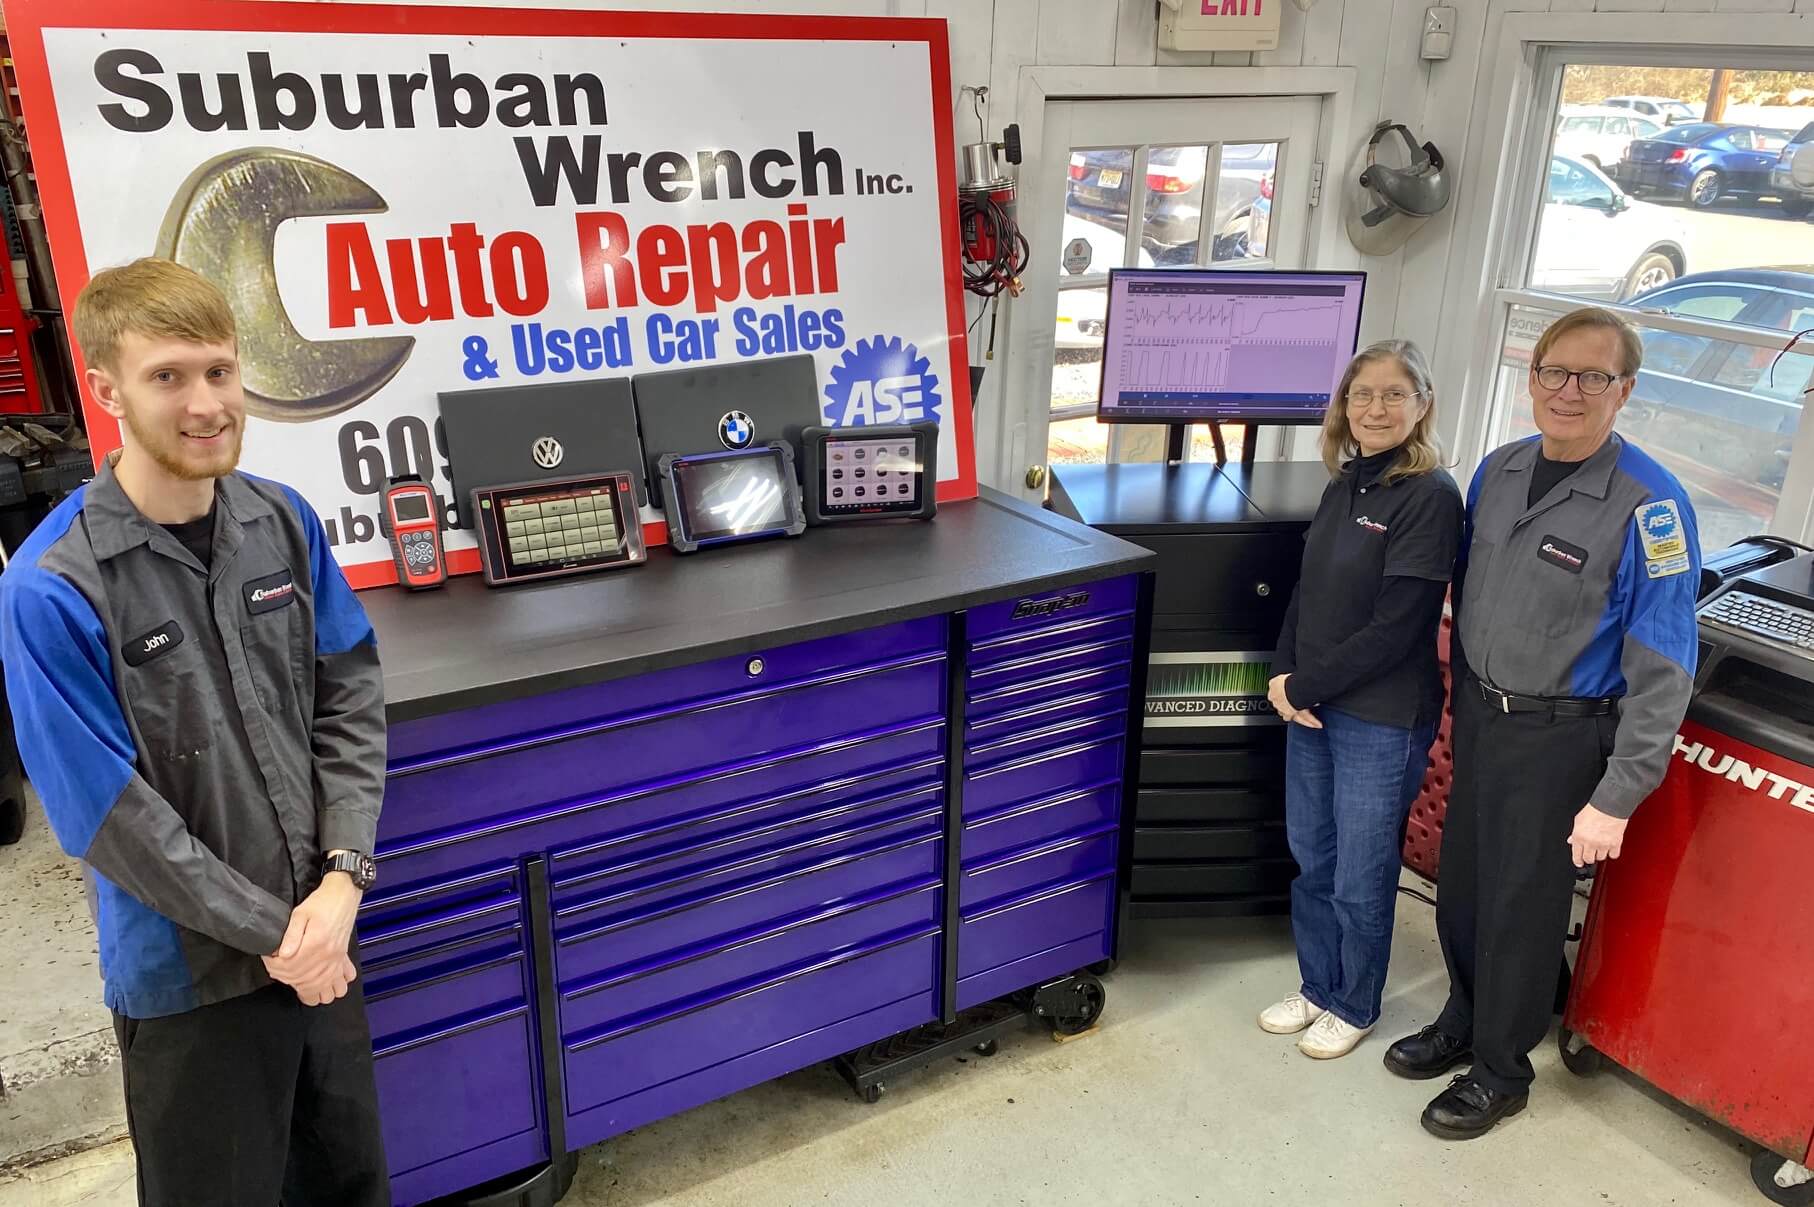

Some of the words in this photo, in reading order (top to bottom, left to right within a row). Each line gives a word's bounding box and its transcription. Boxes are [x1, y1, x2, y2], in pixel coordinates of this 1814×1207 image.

[93, 48, 607, 133] Suburban
[513, 131, 845, 207] Wrench
[855, 168, 913, 195] Inc.
[326, 221, 549, 329] Auto
[575, 203, 846, 313] Repair
[462, 336, 499, 381] &
[511, 316, 632, 376] Used
[646, 313, 719, 364] Car
[733, 304, 845, 357] Sales
[841, 374, 924, 427] ASE
[338, 415, 452, 495] 60
[1648, 513, 1673, 530] ASE
[144, 633, 169, 652] John
[1145, 701, 1206, 713] VANCED
[1208, 699, 1273, 712] DIAGNO
[1671, 734, 1814, 813] HUNTE
